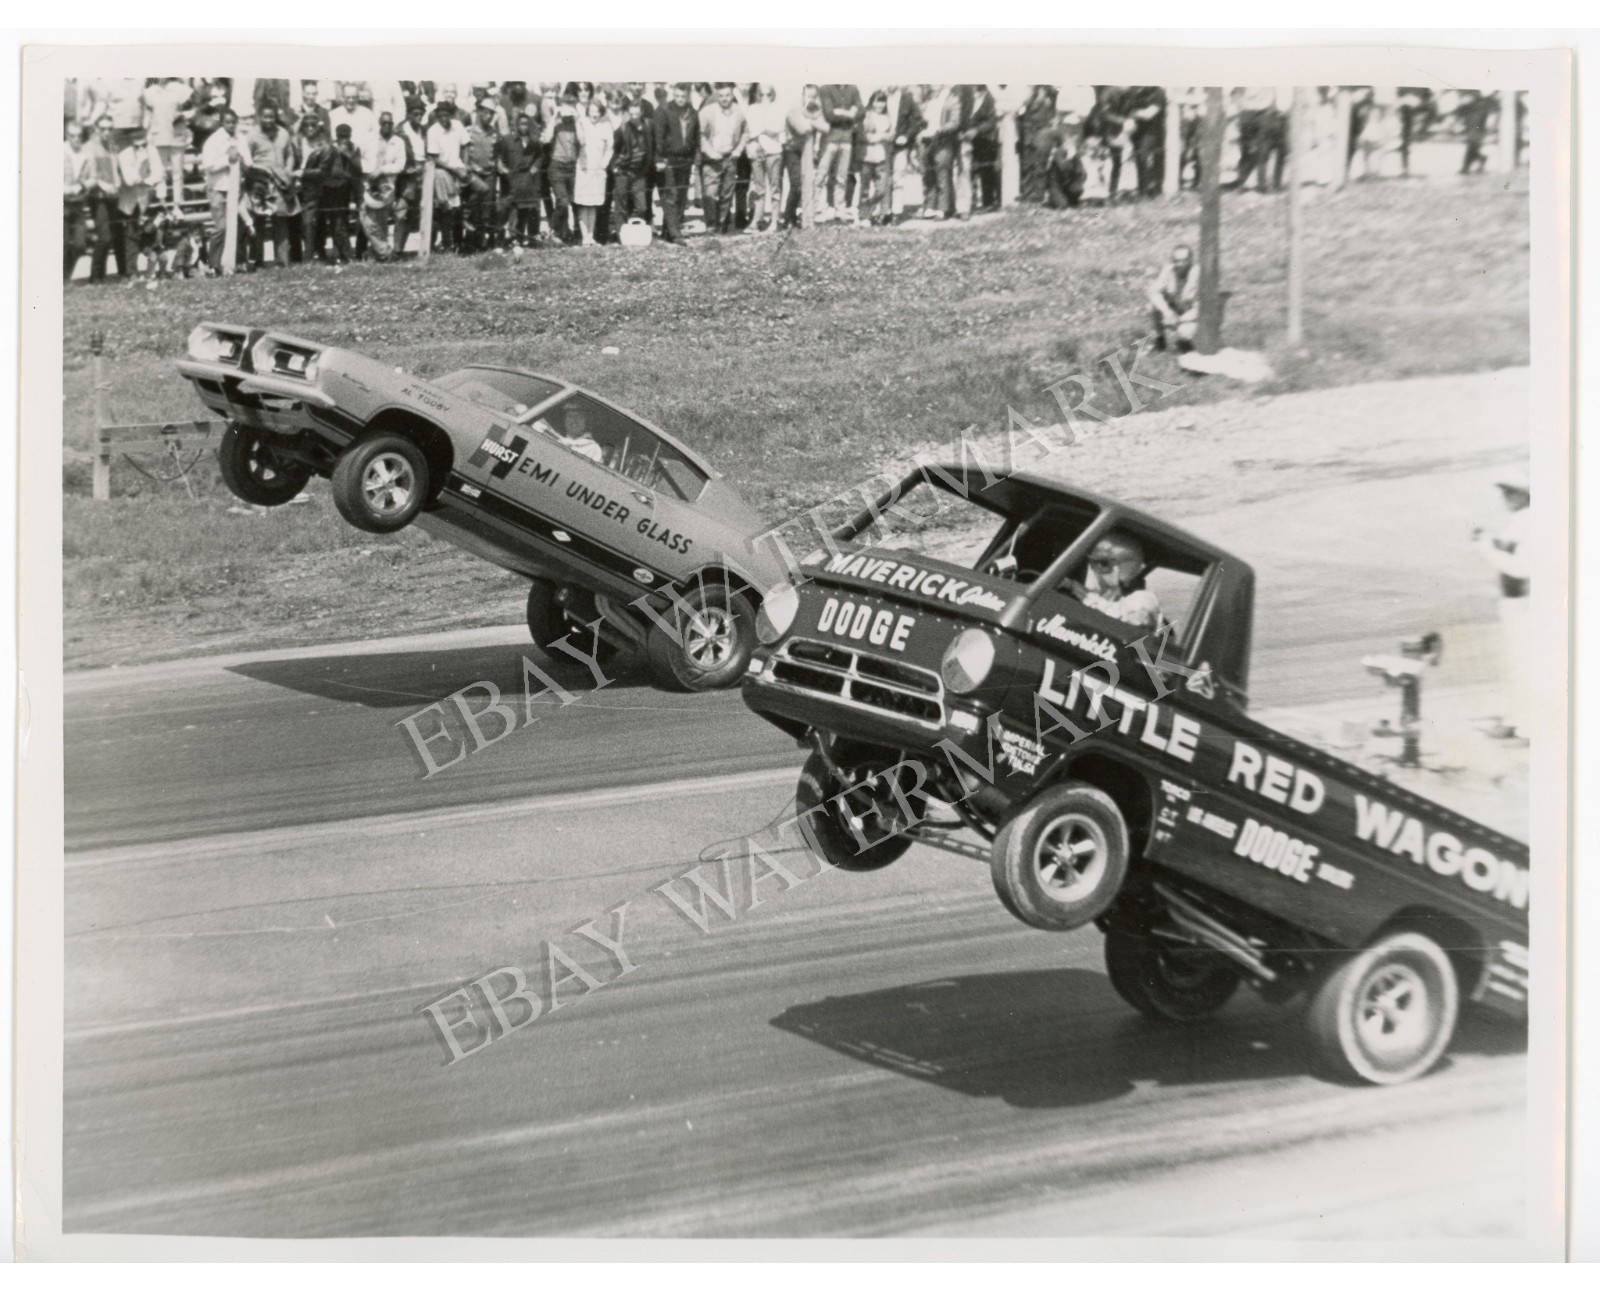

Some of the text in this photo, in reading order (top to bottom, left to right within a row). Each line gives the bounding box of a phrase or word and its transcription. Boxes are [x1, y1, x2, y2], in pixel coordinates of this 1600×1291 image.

[480, 438, 518, 464] HURST
[566, 480, 630, 524] UNDER
[636, 518, 693, 554] GLASS
[824, 552, 968, 600] MAVERICK
[817, 598, 915, 651] DODGE
[1038, 658, 1201, 763] LITTLE
[1227, 741, 1325, 814] RED
[1234, 818, 1320, 884] DODGE
